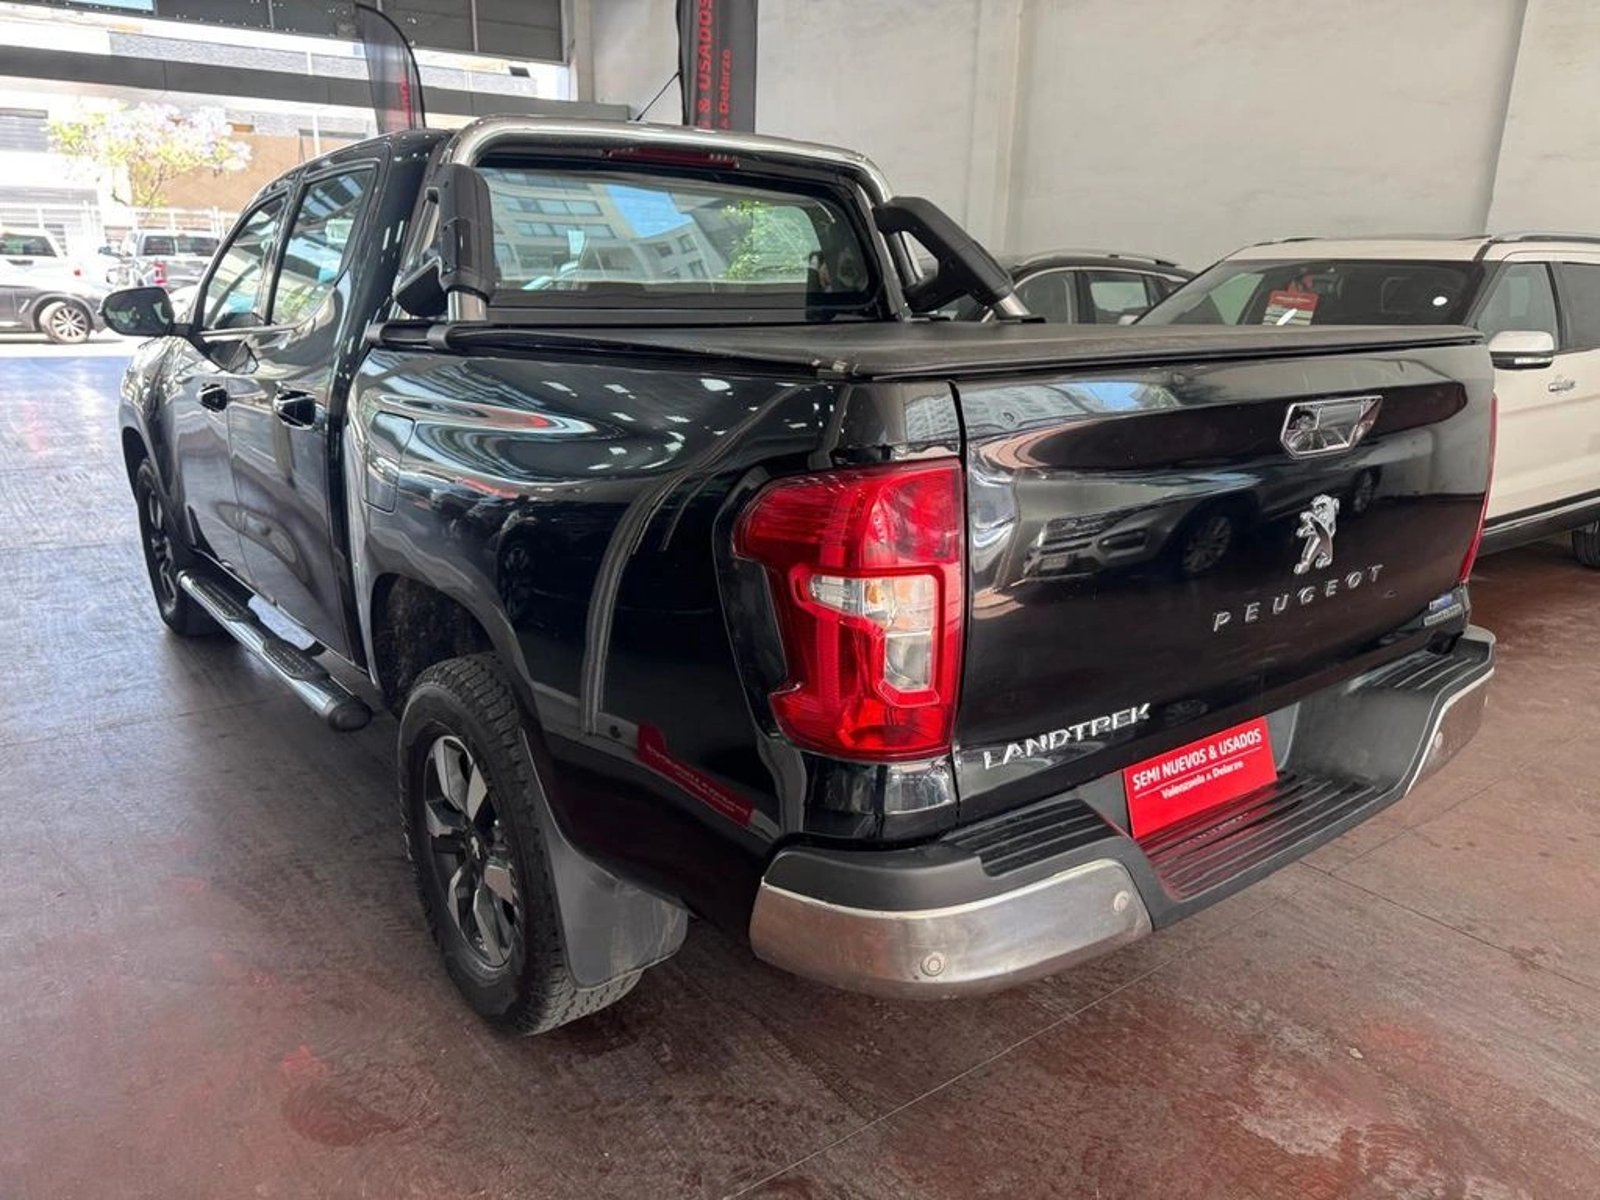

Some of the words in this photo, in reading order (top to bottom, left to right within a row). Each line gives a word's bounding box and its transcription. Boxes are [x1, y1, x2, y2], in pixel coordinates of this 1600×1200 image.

[698, 0, 712, 91] USADOS
[1212, 564, 1384, 632] PEUGEOT
[983, 702, 1151, 770] LANDTREK
[1132, 768, 1160, 791] SEMI
[1162, 749, 1207, 780] NUEVOS
[1208, 747, 1218, 759] &
[1219, 728, 1261, 755] USADOS
